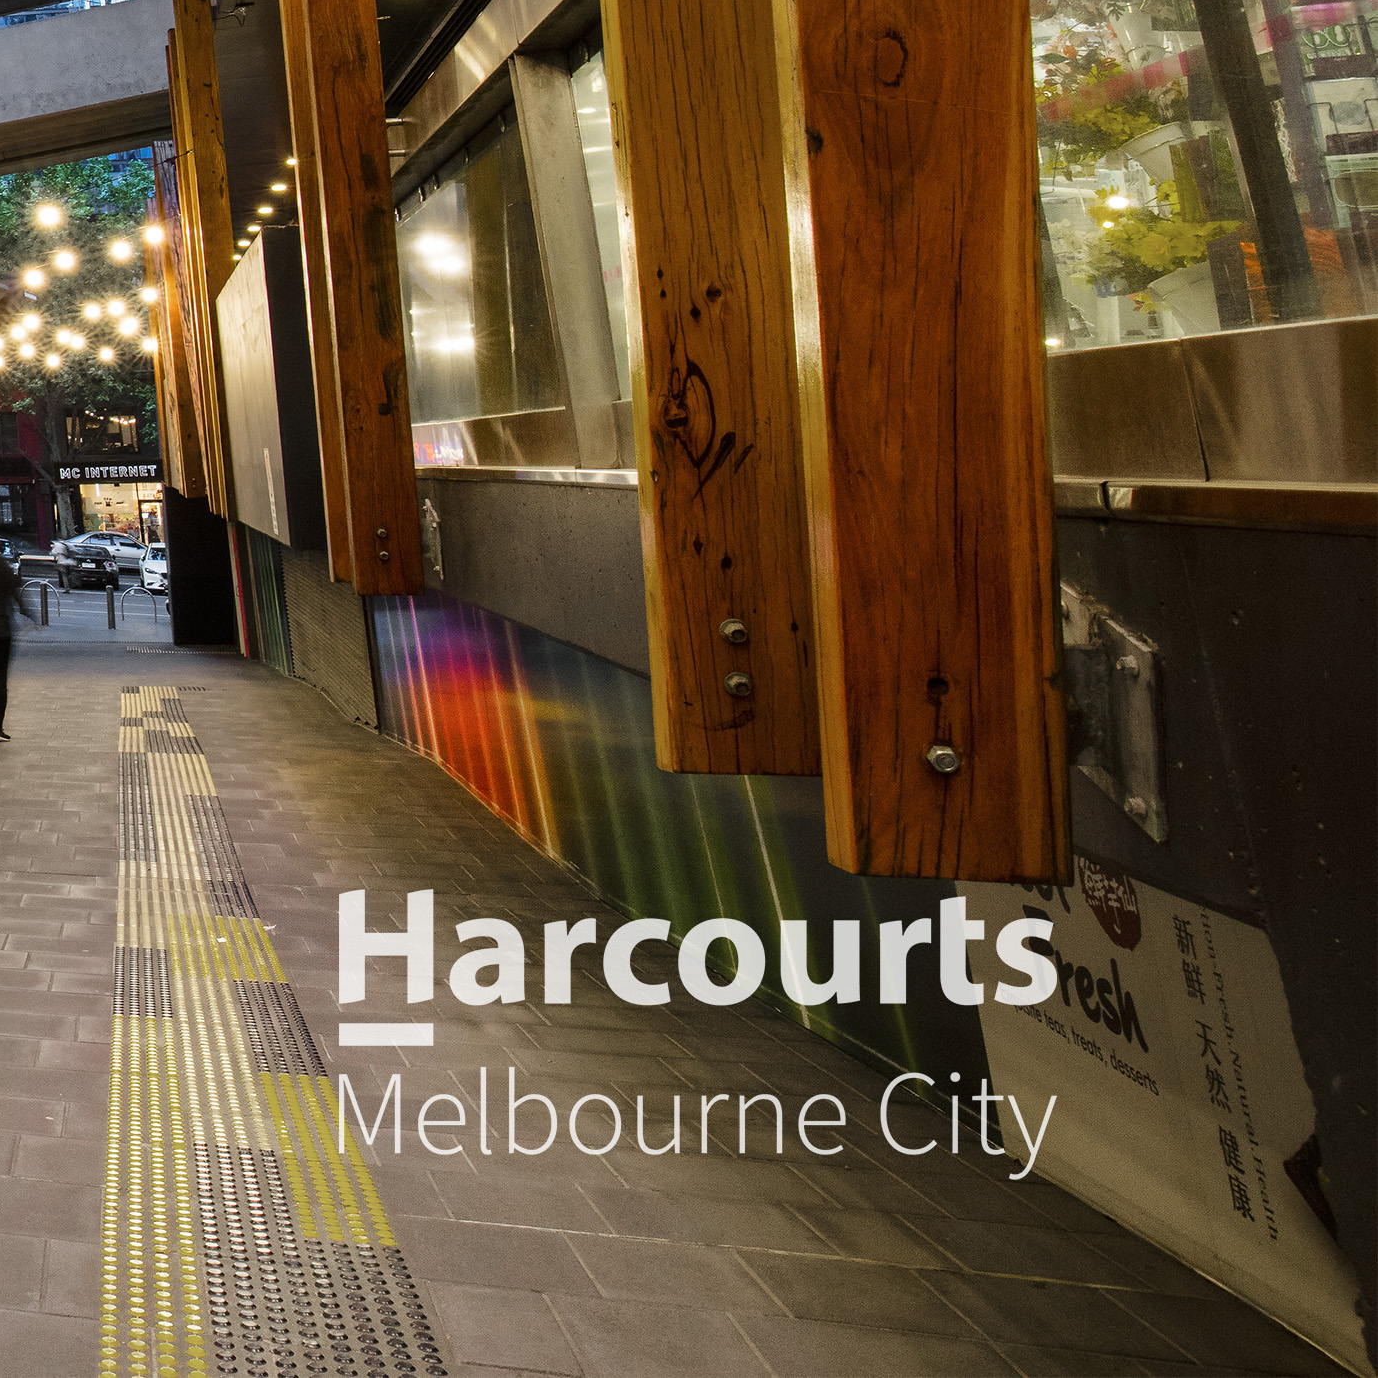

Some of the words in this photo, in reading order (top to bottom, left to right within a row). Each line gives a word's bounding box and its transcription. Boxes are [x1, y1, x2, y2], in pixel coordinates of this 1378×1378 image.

[60, 468, 80, 480] MC
[85, 465, 156, 478] INTERNET
[1043, 1010, 1071, 1044] teas,
[1071, 1026, 1107, 1068] treats,
[1110, 1050, 1159, 1096] desserts
[1172, 914, 1206, 1004] 新鮮
[1195, 1019, 1233, 1113] 天然
